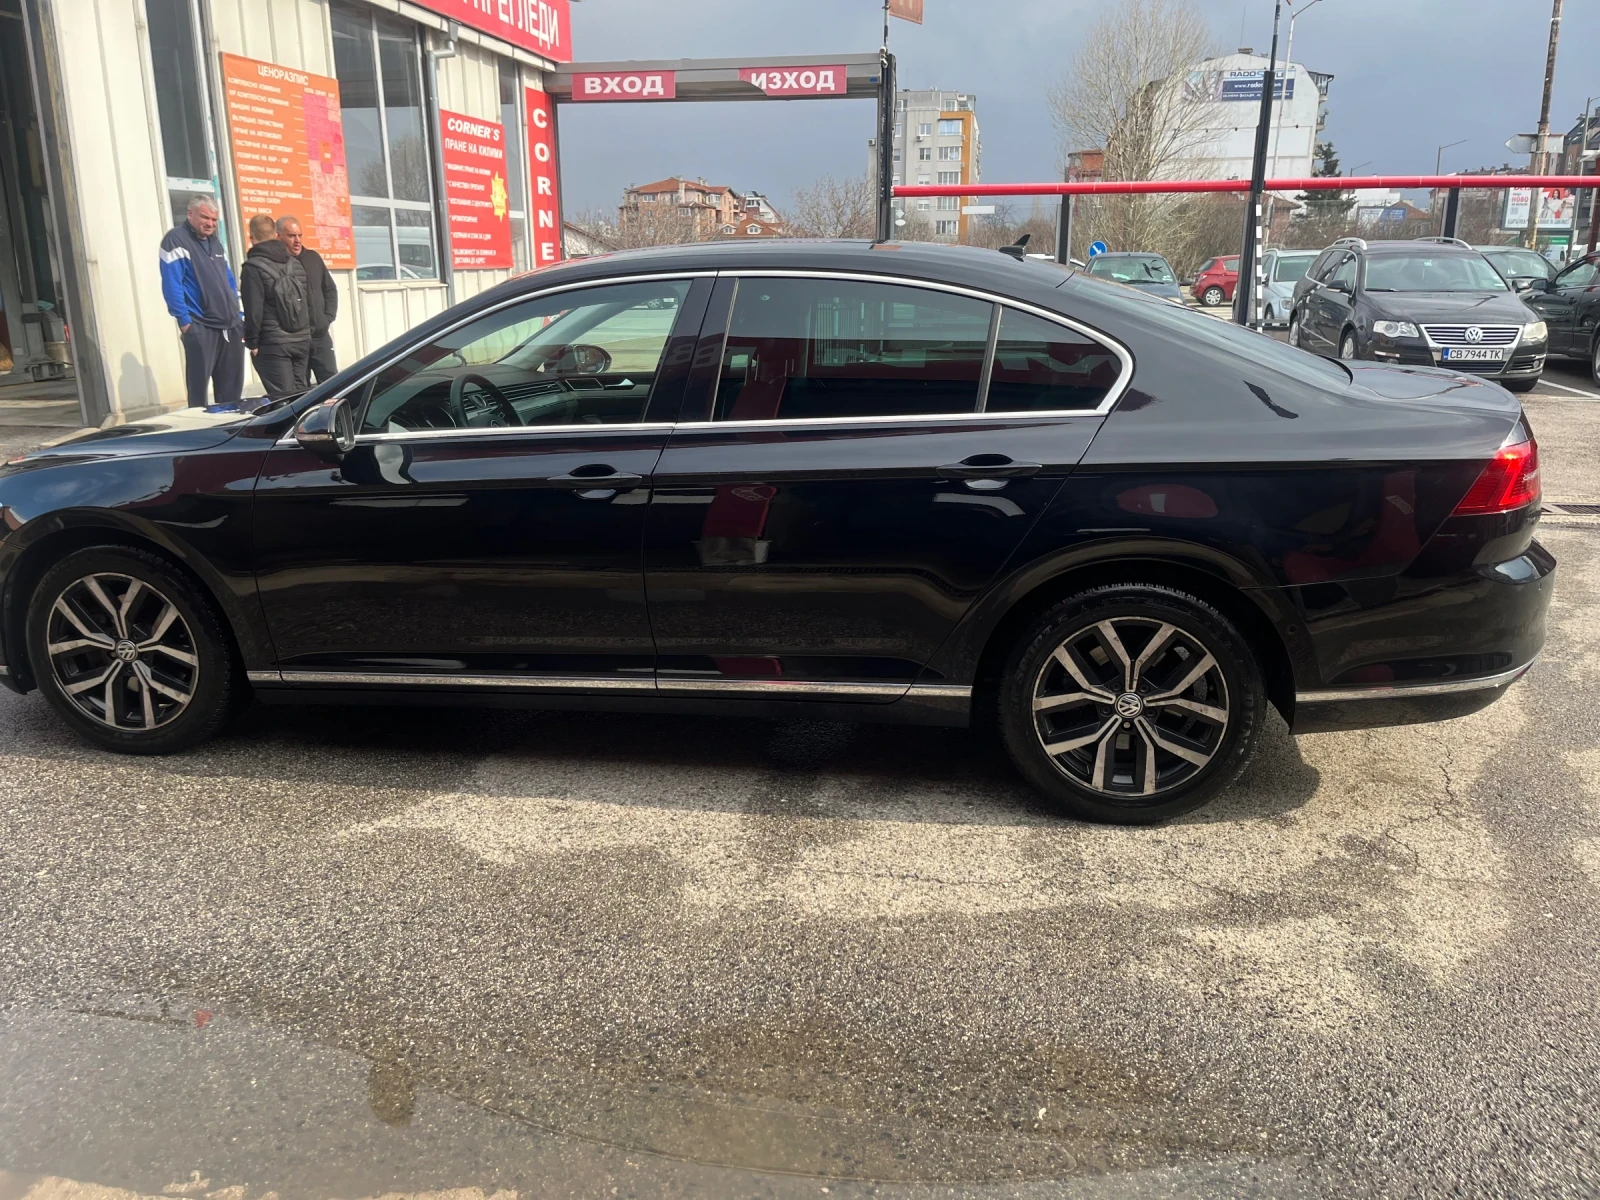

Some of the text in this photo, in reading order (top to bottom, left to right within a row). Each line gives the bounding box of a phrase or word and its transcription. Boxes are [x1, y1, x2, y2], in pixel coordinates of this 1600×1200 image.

[473, 0, 559, 50] ЕГЛЕДИ
[257, 64, 309, 86] ЦЕНОРАЗПИС
[584, 75, 664, 96] ВХОД
[751, 71, 835, 91] ИЗХОД
[445, 137, 503, 159] ПРАНЕ НА КИЛИМИ
[1450, 349, 1501, 360] CB 7944 TK
